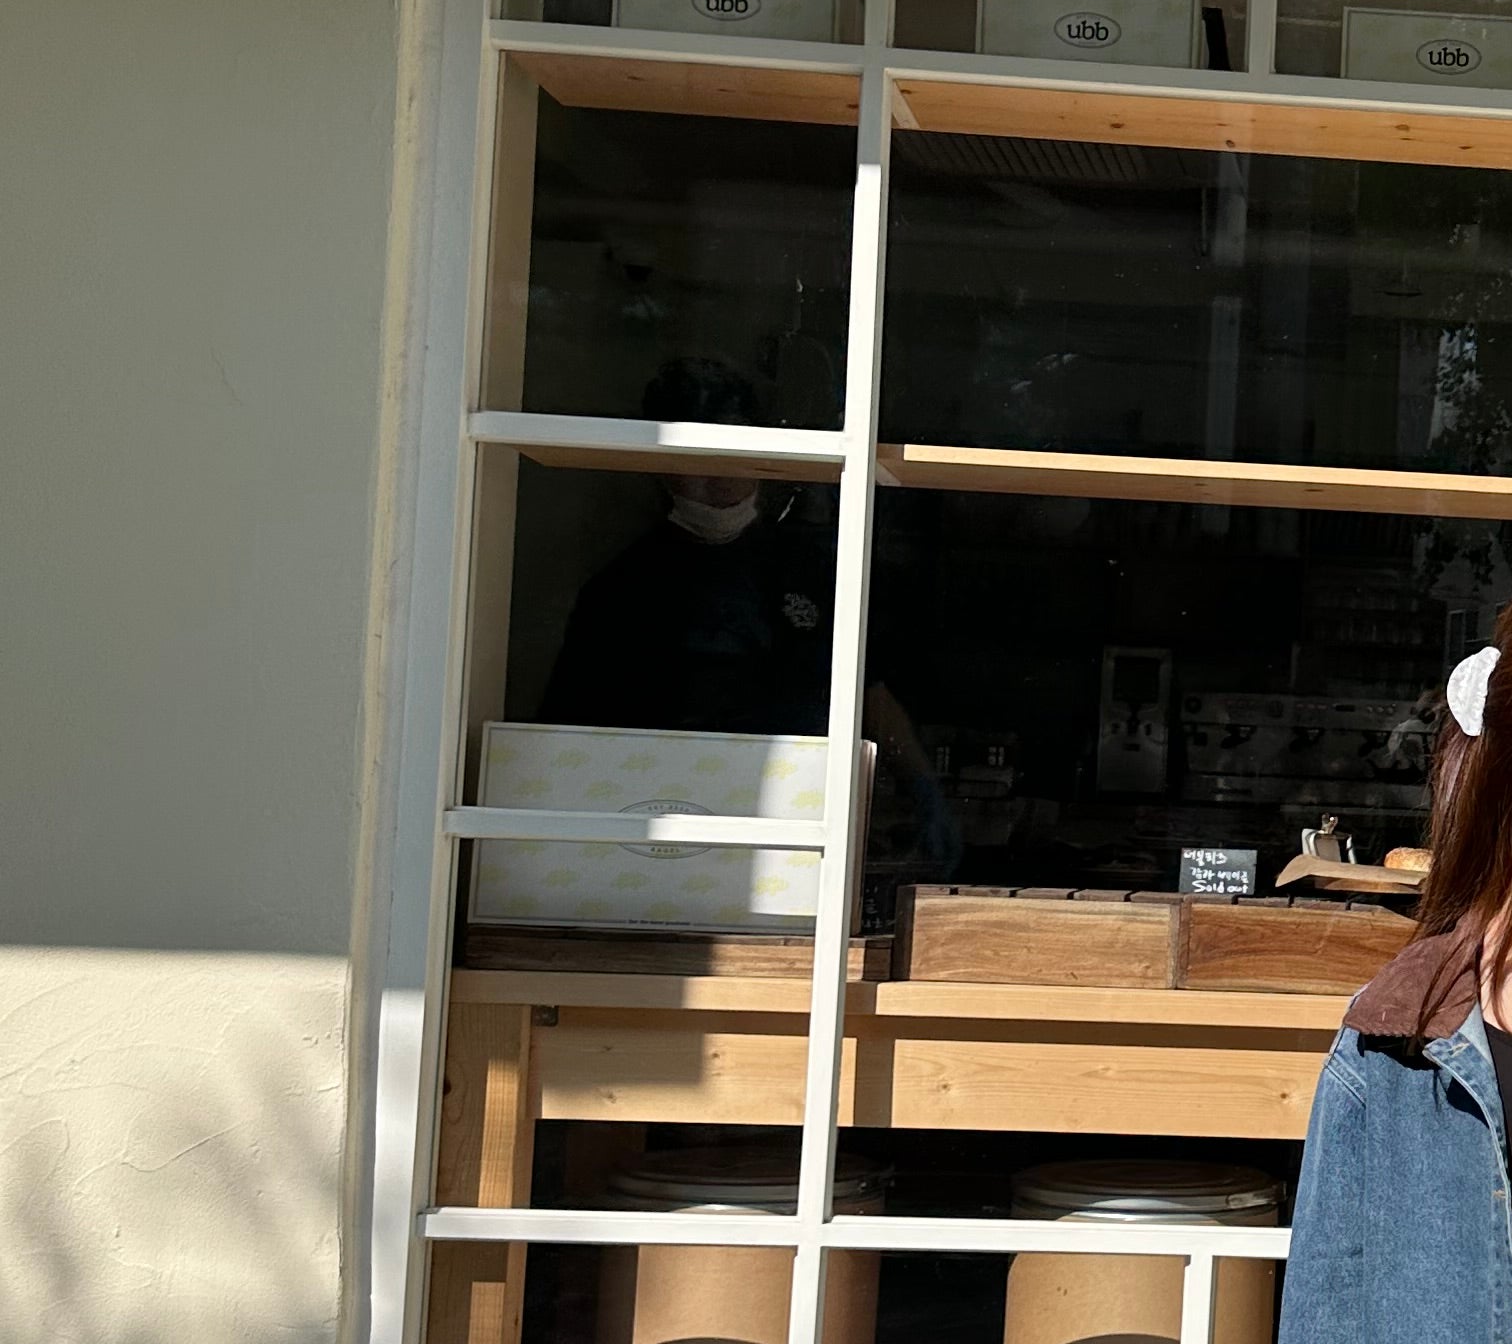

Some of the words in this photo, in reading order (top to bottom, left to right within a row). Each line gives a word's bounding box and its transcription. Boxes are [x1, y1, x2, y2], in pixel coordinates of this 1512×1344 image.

[1067, 20, 1109, 41] ubb
[1428, 47, 1469, 67] ubb
[1191, 879, 1225, 894] Sold
[1226, 884, 1249, 894] out
